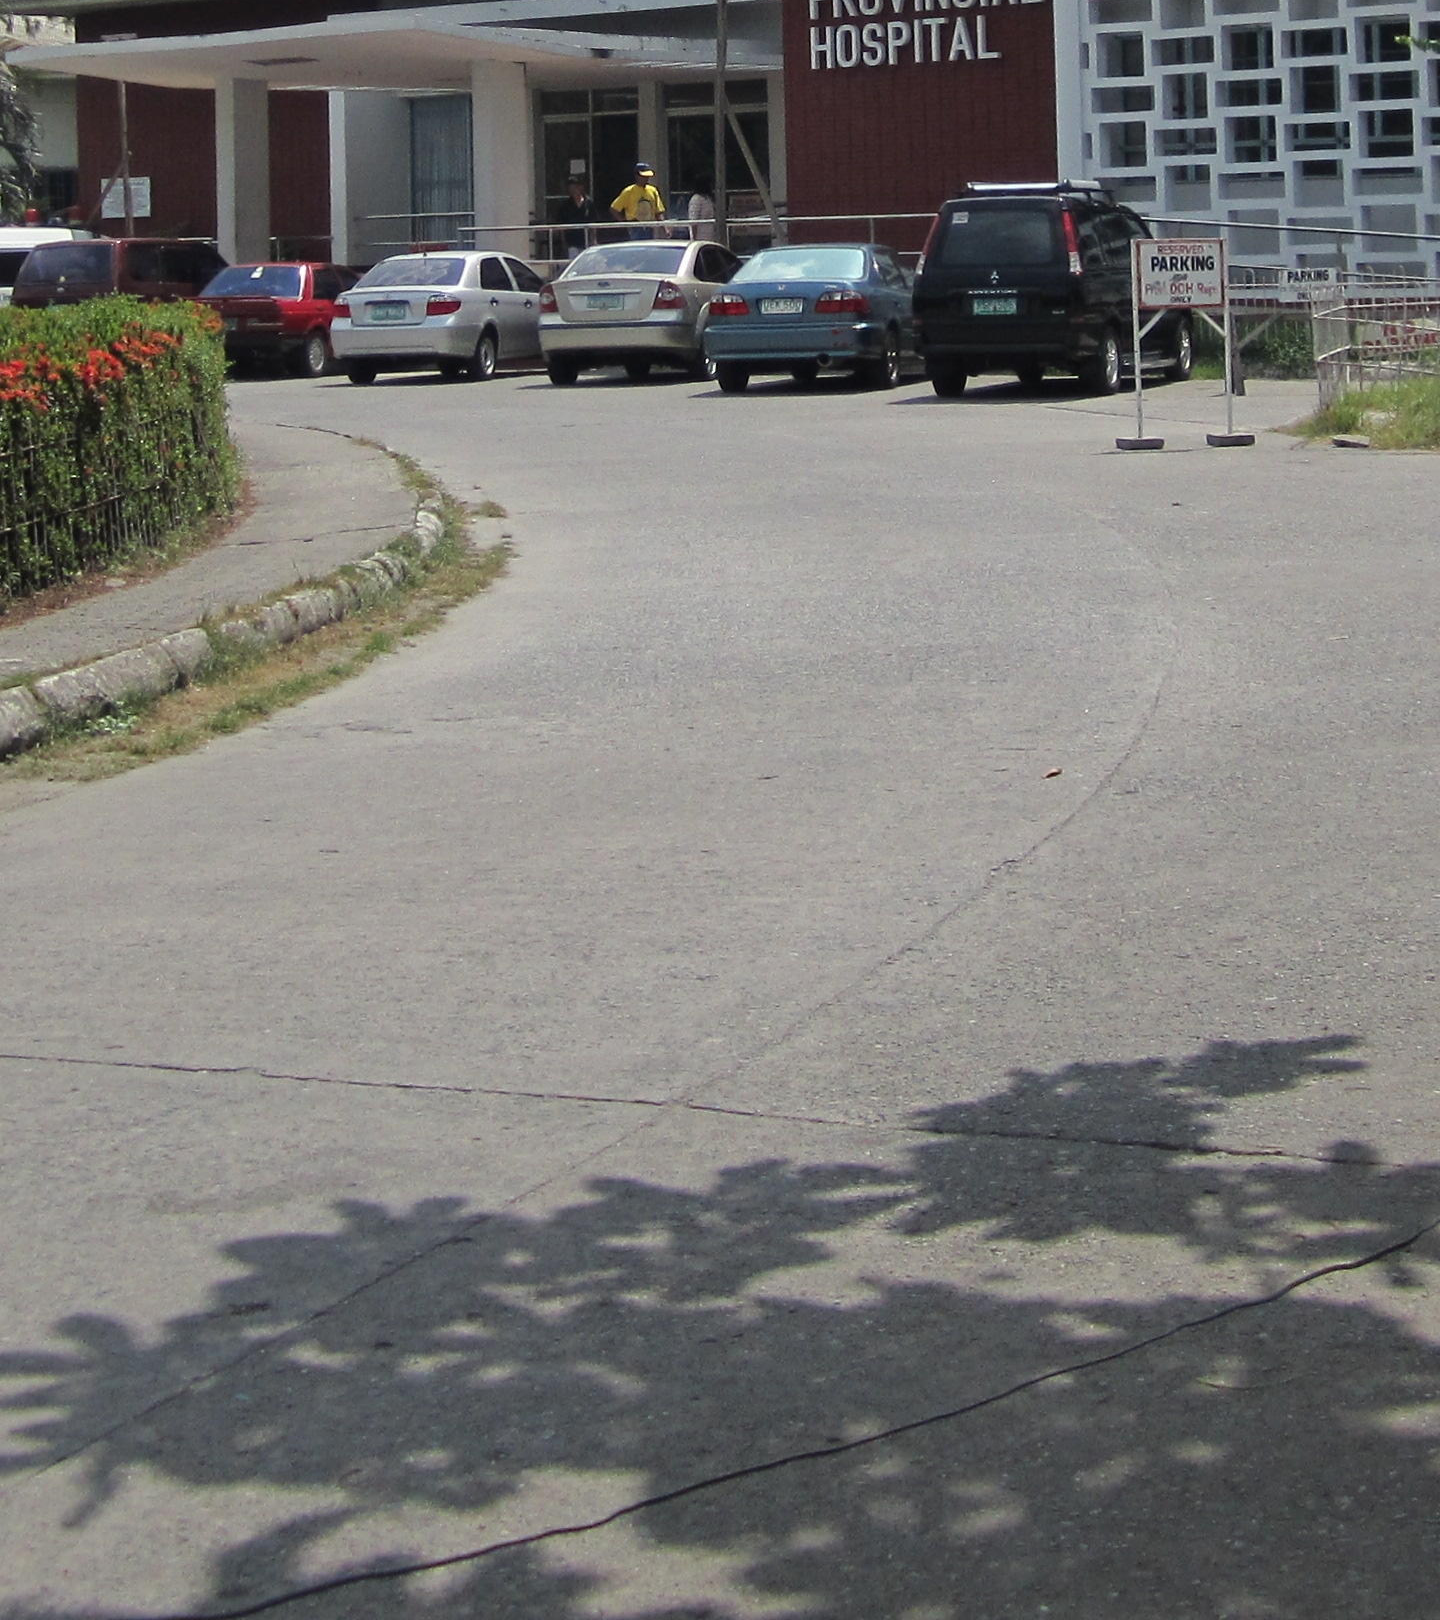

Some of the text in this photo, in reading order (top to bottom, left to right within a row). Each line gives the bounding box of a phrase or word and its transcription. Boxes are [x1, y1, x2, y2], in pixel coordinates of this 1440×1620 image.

[809, 14, 1003, 70] HOSPITAL
[1157, 245, 1205, 254] RESERVED
[1150, 256, 1215, 272] PARKING
[1287, 270, 1329, 283] PARKING
